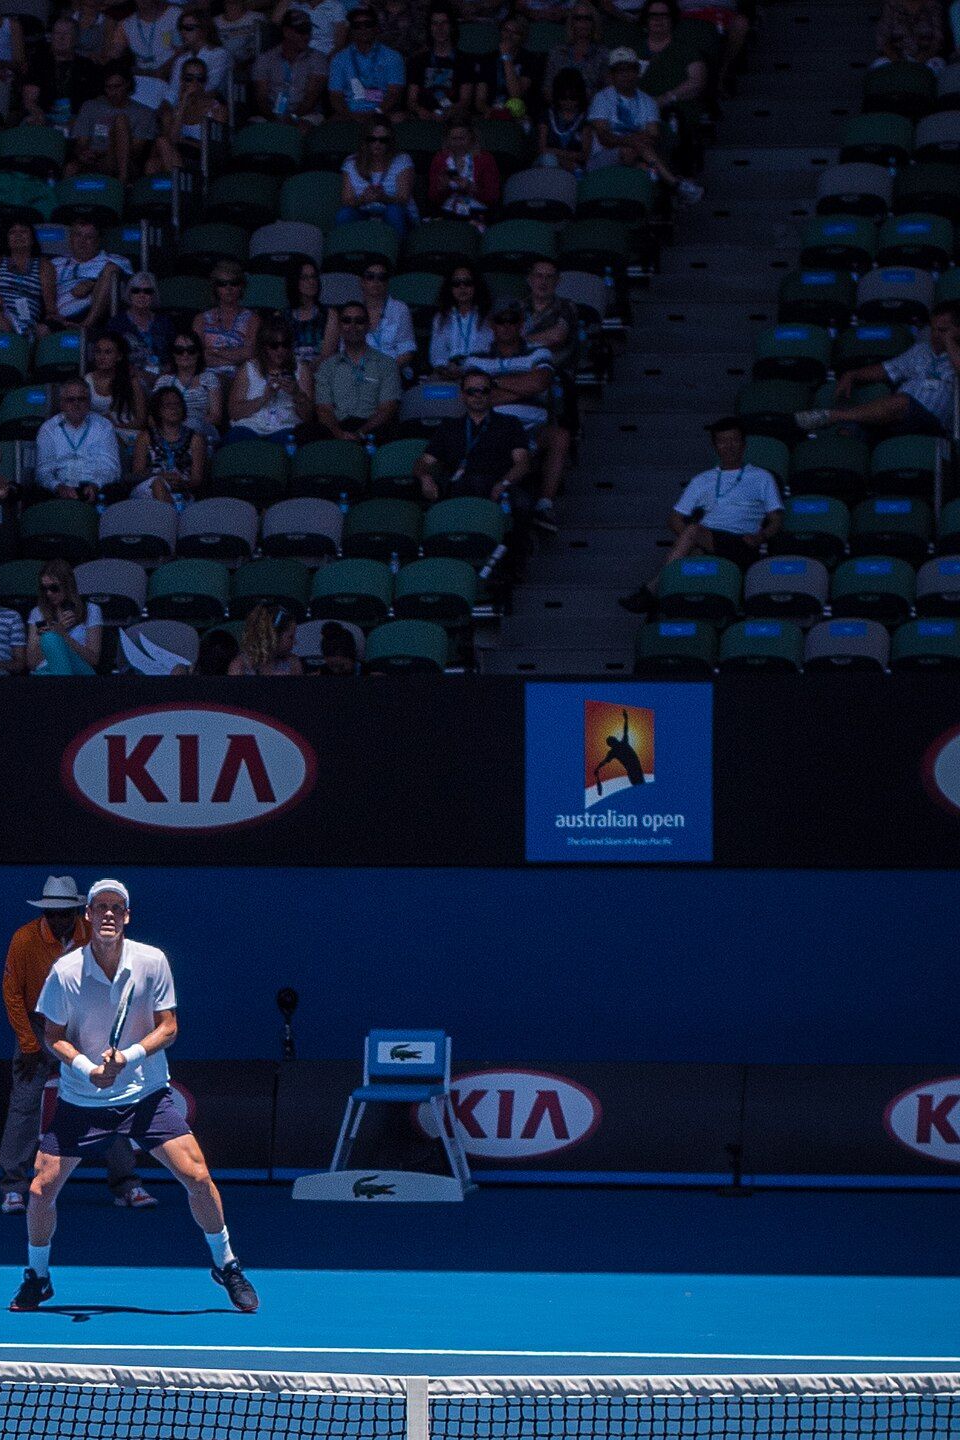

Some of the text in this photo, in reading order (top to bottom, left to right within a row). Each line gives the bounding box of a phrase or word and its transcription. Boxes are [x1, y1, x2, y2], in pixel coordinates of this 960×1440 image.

[104, 734, 277, 803] KIA
[555, 809, 685, 832] australian open
[443, 1089, 570, 1140] KIA
